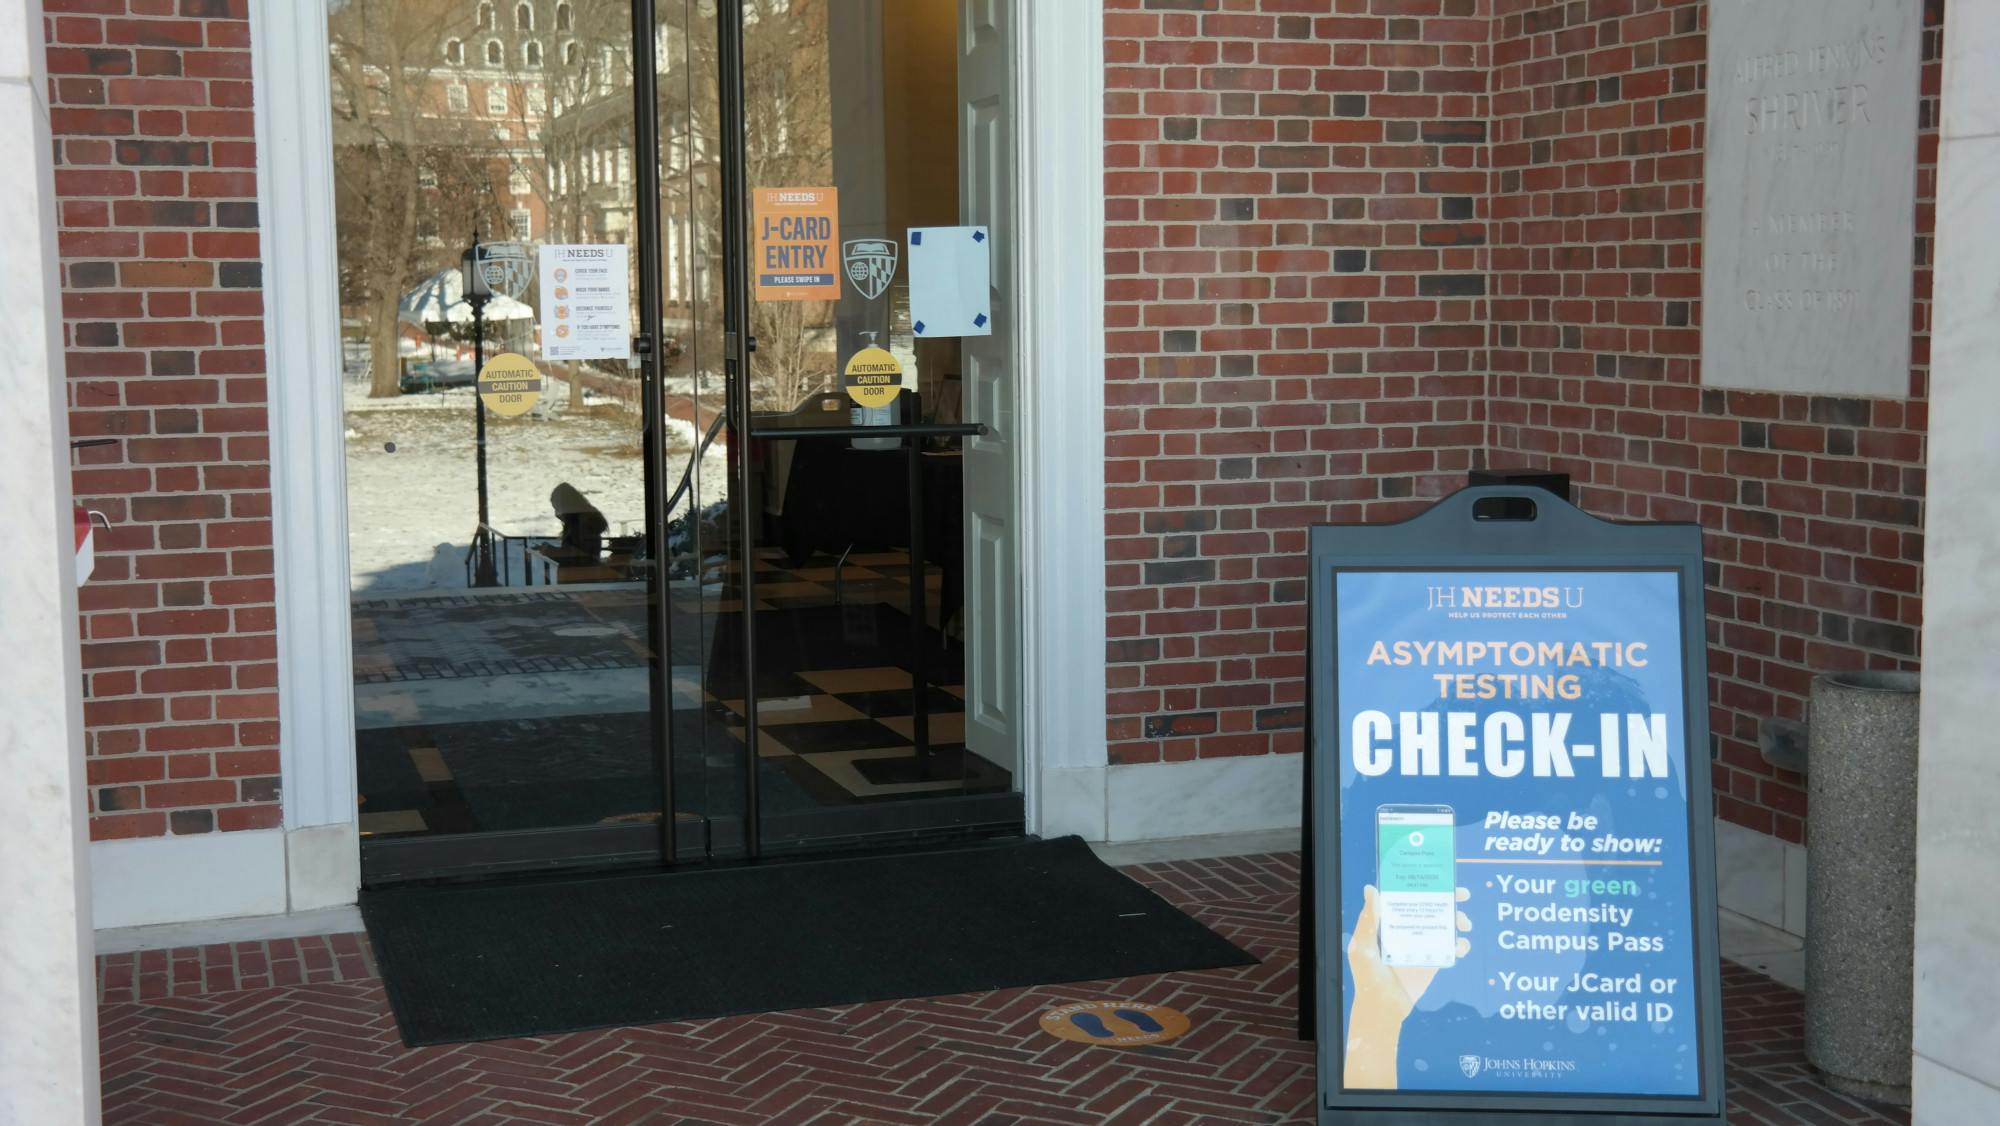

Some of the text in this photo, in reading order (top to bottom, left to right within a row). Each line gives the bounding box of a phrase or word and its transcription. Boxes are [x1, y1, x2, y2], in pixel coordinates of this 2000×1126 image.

[1744, 84, 1872, 136] SHRIVER
[779, 192, 816, 202] NEEDS
[762, 216, 831, 240] J-CARD
[567, 249, 604, 258] NEEDS
[766, 245, 828, 270] ENTRY
[774, 276, 795, 284] PLEASE
[796, 276, 813, 284] SWIPE
[486, 369, 533, 379] AUTOMATIC
[852, 364, 896, 373] AUTOMATIC
[492, 381, 528, 391] CAUTION
[857, 375, 890, 384] CAUTION
[499, 394, 522, 403] DOOR
[863, 387, 885, 396] DOOR
[1461, 586, 1560, 608] NEEDS
[1366, 640, 1649, 668] ASYMPTOMATIC
[1433, 673, 1582, 700] TESTING
[1352, 709, 1669, 778] CHECK-IN
[1484, 811, 1598, 831] Please be
[1484, 833, 1663, 855] ready to show:
[1496, 874, 1637, 898] Your green
[1498, 902, 1633, 927] Prodensity
[1498, 931, 1664, 954] Campus Pass
[1498, 972, 1677, 994] Your JCard or
[1103, 1001, 1158, 1012] HERE
[1500, 1000, 1674, 1022] other valid ID
[1483, 1057, 1576, 1072] JOHNS HOPKINS
[1496, 1071, 1562, 1079] UNIVERSITY
